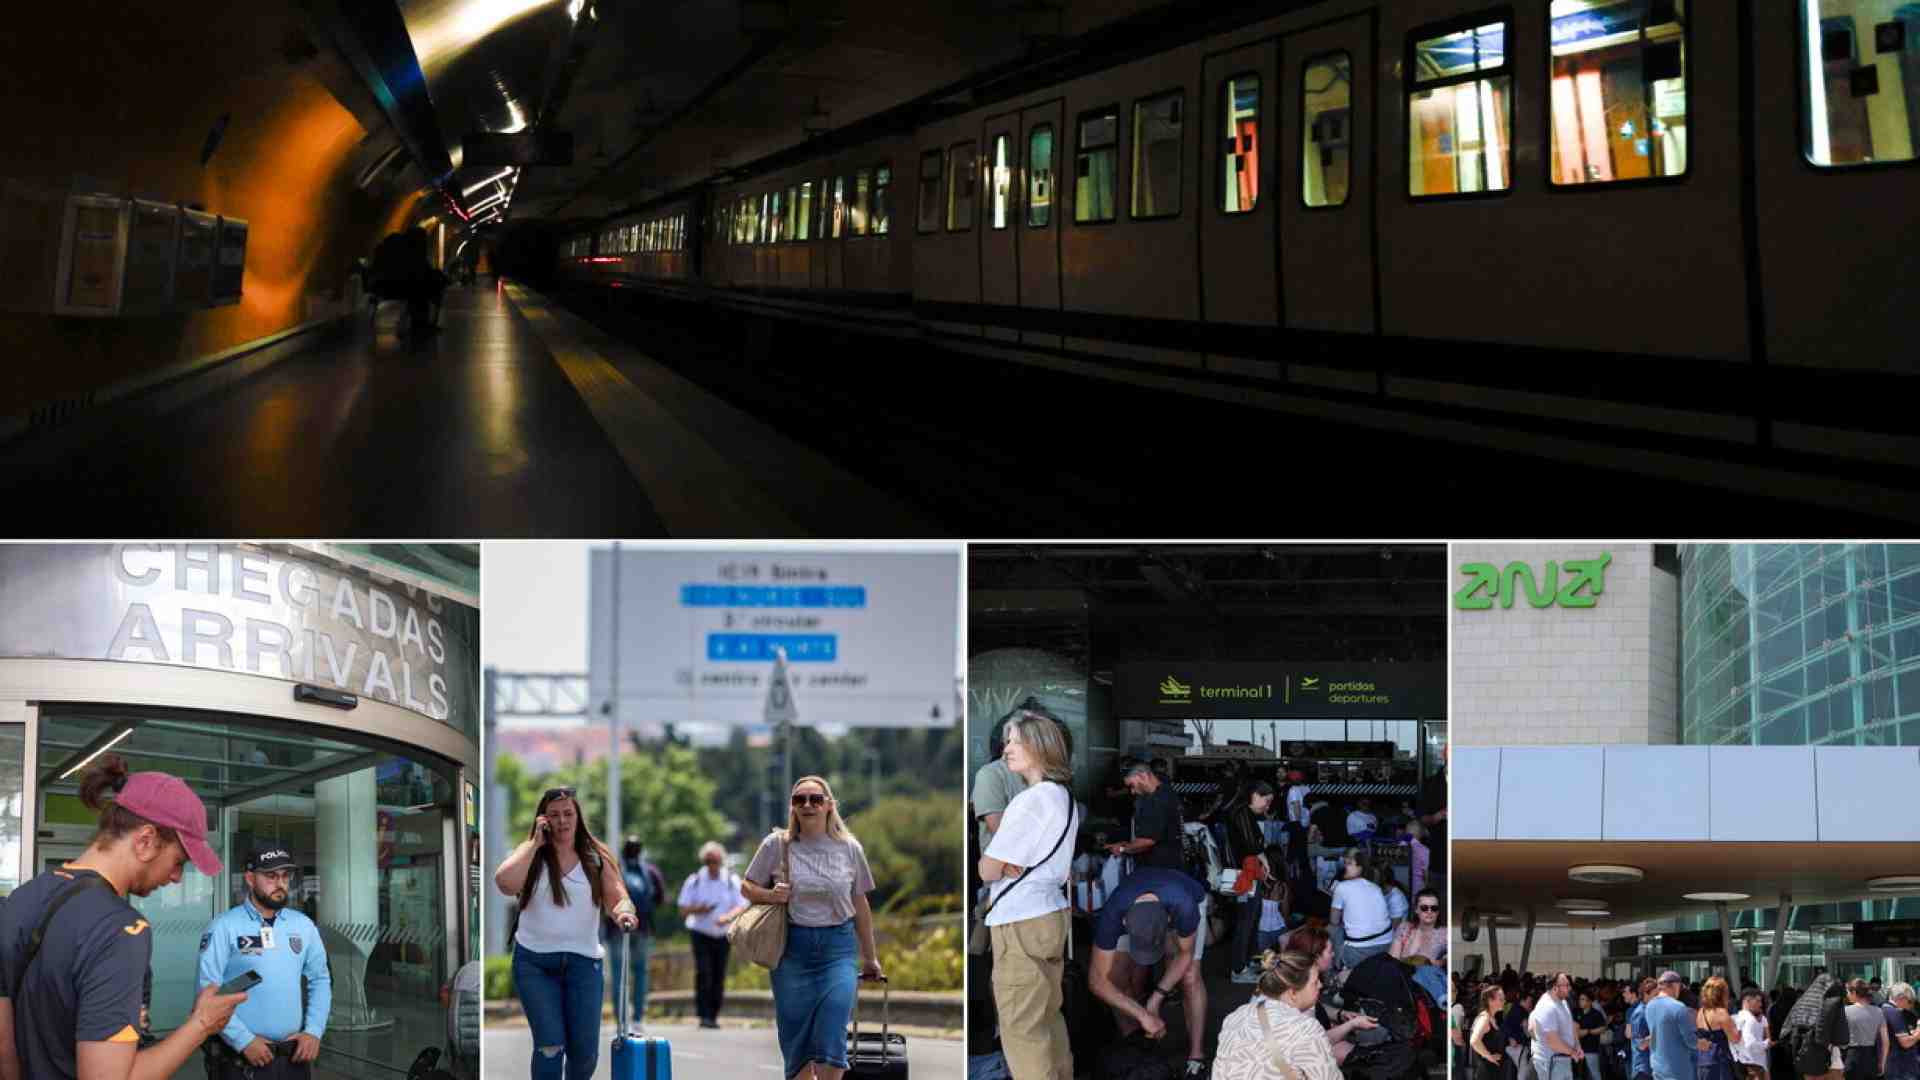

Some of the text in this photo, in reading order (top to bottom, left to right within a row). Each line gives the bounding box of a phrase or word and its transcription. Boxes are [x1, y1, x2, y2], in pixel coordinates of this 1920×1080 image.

[111, 544, 445, 665] CHEGADAS
[106, 602, 448, 720] ARRIVALS
[1200, 684, 1273, 699] terminal 1
[1329, 680, 1376, 693] partidas
[1329, 693, 1390, 705] departures
